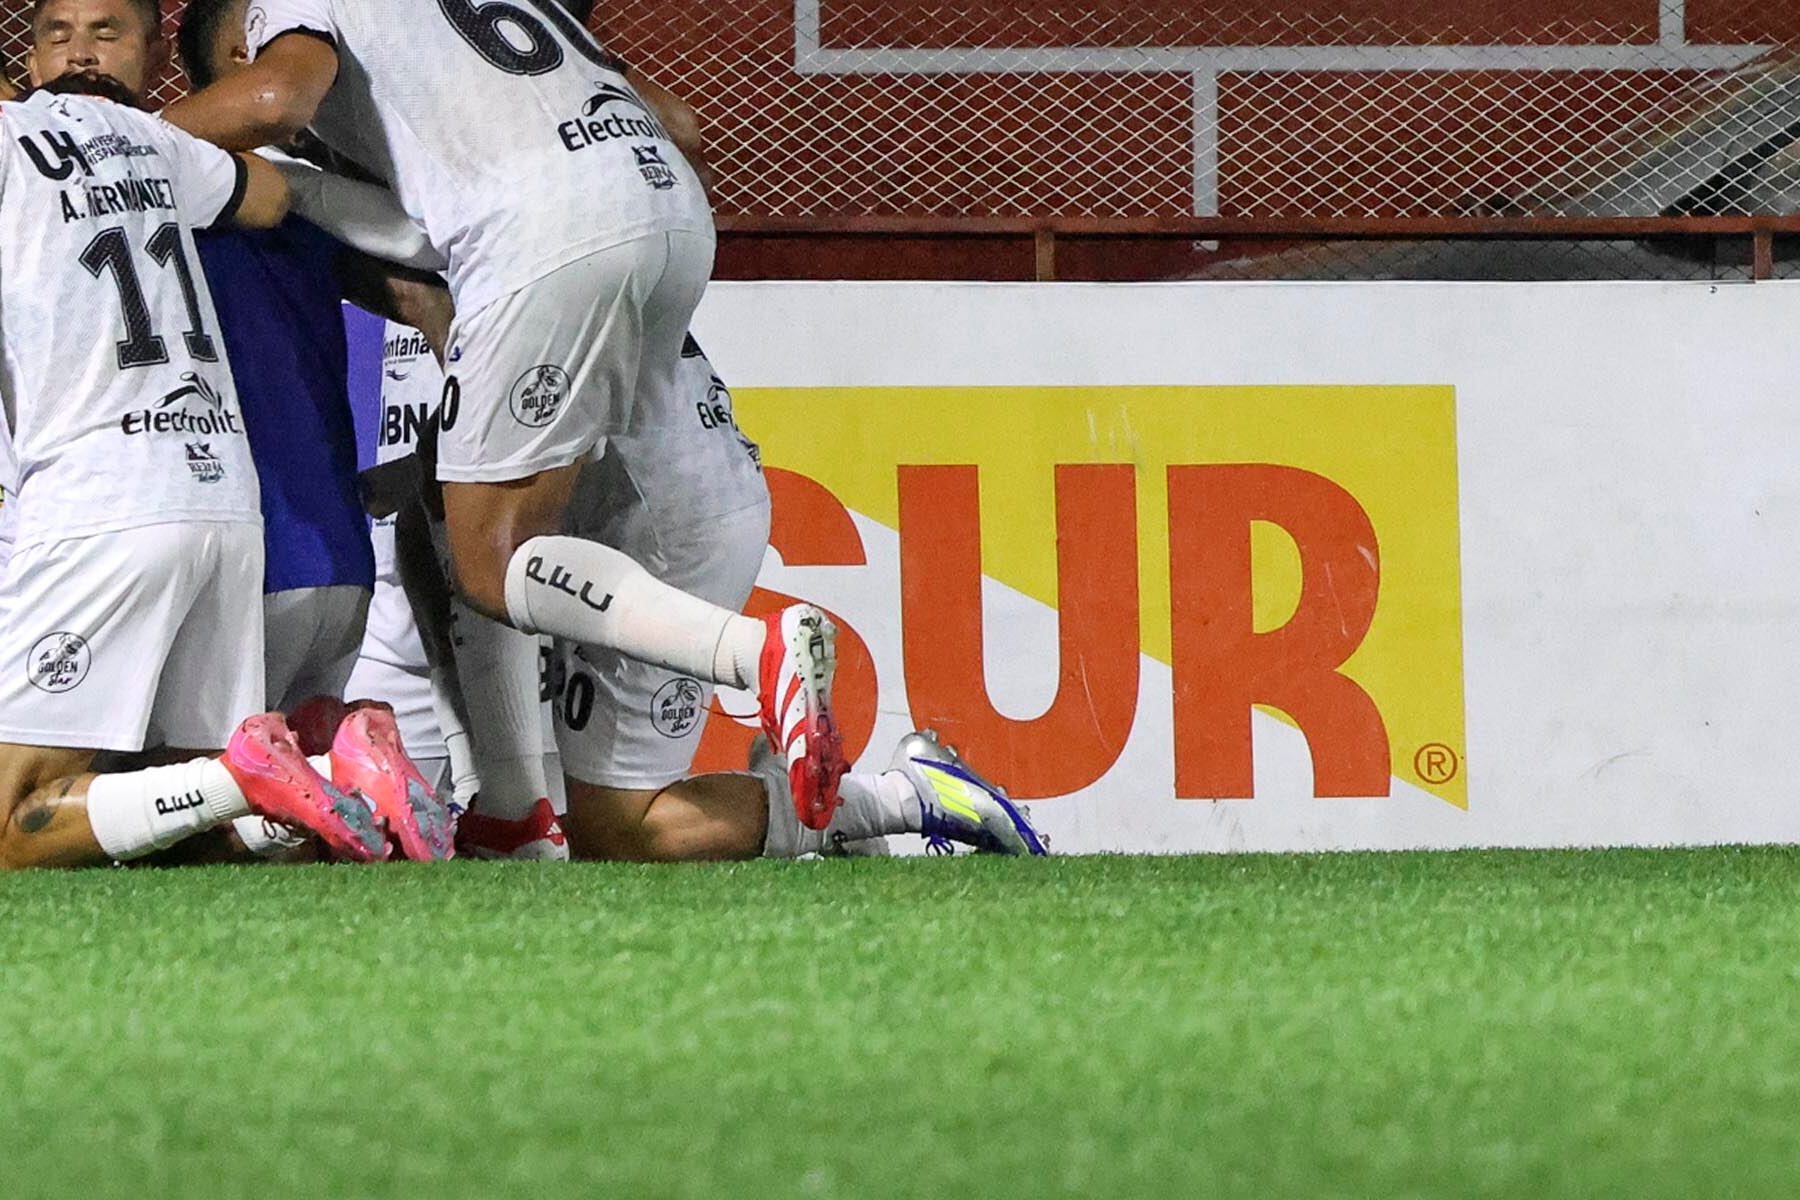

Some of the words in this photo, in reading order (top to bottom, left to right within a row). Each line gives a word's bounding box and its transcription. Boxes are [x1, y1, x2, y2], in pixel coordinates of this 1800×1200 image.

[60, 190, 86, 223] A.
[79, 222, 218, 370] 11
[121, 407, 241, 435] Electrolit
[526, 556, 614, 612] PFC
[690, 463, 1391, 800] SUR
[156, 789, 204, 815] PFC
